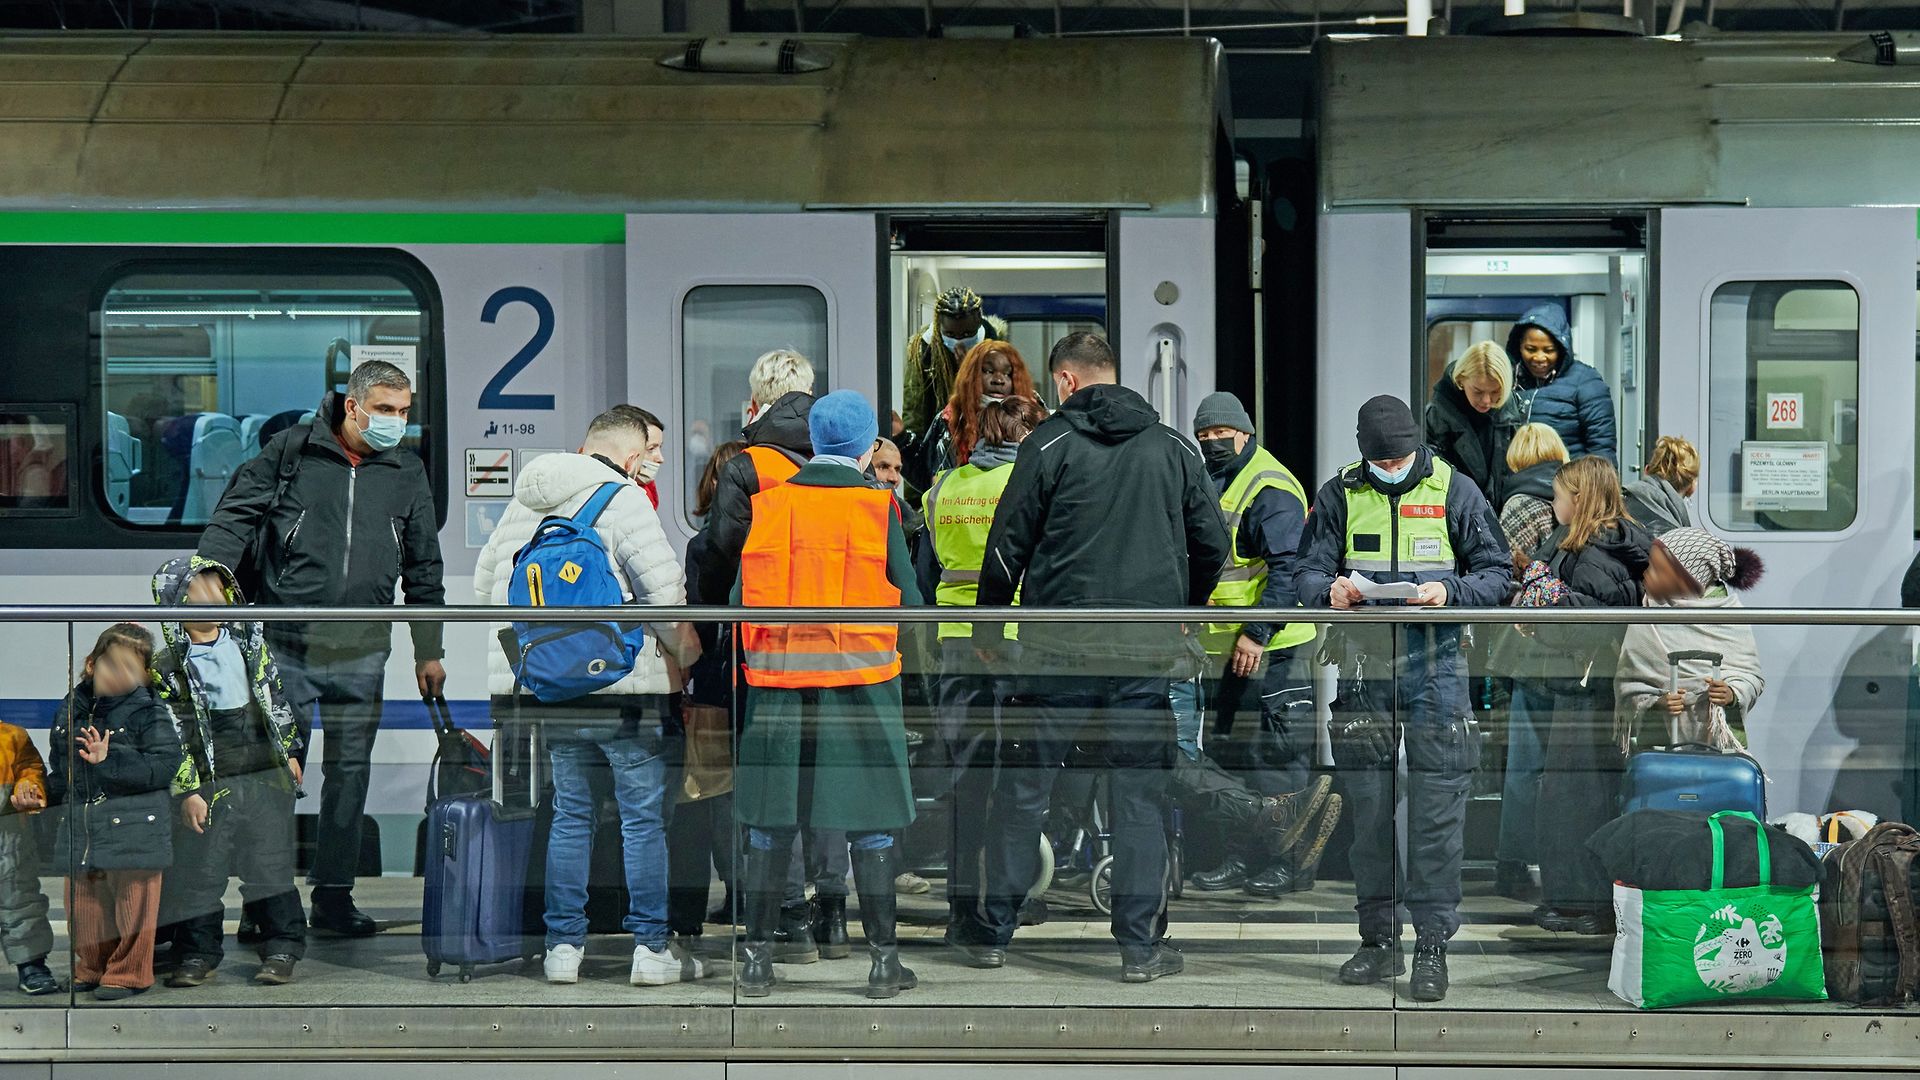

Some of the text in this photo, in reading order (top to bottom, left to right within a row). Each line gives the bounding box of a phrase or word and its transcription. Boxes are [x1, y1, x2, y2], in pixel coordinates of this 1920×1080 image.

[478, 286, 555, 410] 2
[1771, 400, 1797, 422] 268
[502, 424, 535, 435] 11-98
[942, 497, 952, 505] Im
[954, 496, 987, 507] Auftrag
[1413, 507, 1434, 515] MUG
[940, 515, 952, 524] DB
[1734, 950, 1752, 959] ZERO
